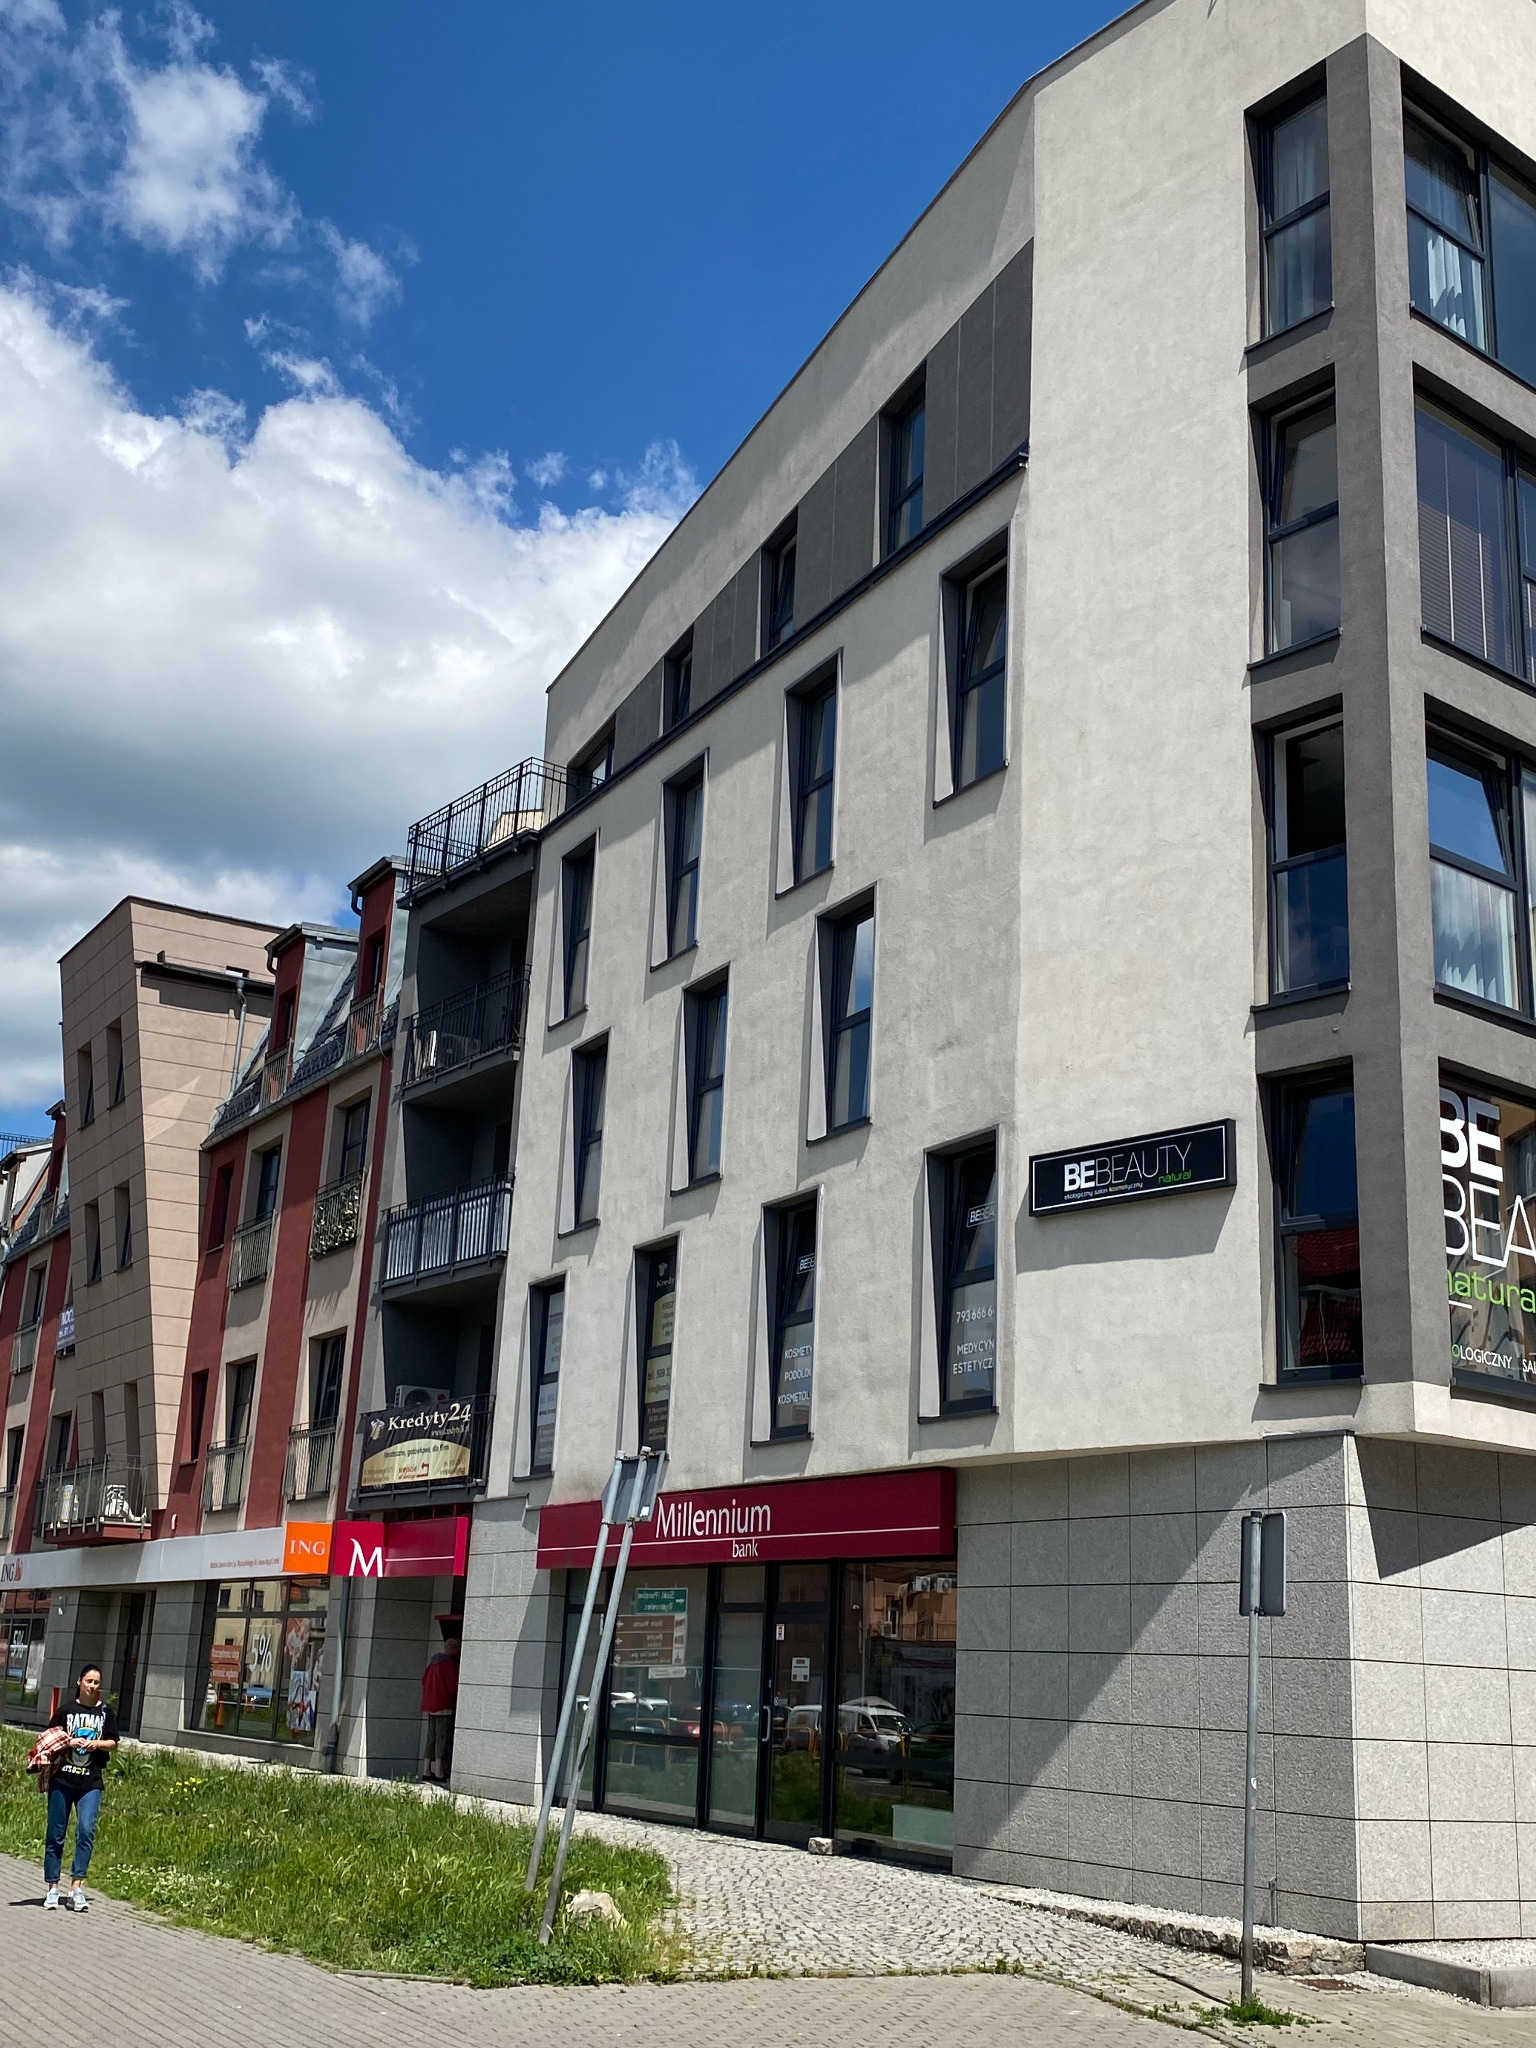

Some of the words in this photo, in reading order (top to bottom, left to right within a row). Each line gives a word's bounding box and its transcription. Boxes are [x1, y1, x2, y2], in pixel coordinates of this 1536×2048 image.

[1158, 1169, 1192, 1184] natural
[1064, 1190, 1093, 1200] ekologiczny
[1094, 1188, 1108, 1196] salon
[1108, 1182, 1143, 1193] kosmetyczny
[956, 1338, 995, 1356] MEDYCYN
[388, 1402, 472, 1431] Kredyty24
[656, 1497, 771, 1538] Millennium
[289, 1539, 326, 1556] ING
[732, 1539, 759, 1558] bank
[349, 1538, 383, 1577] M
[1, 1563, 15, 1582] ING
[248, 1634, 272, 1673] 5%
